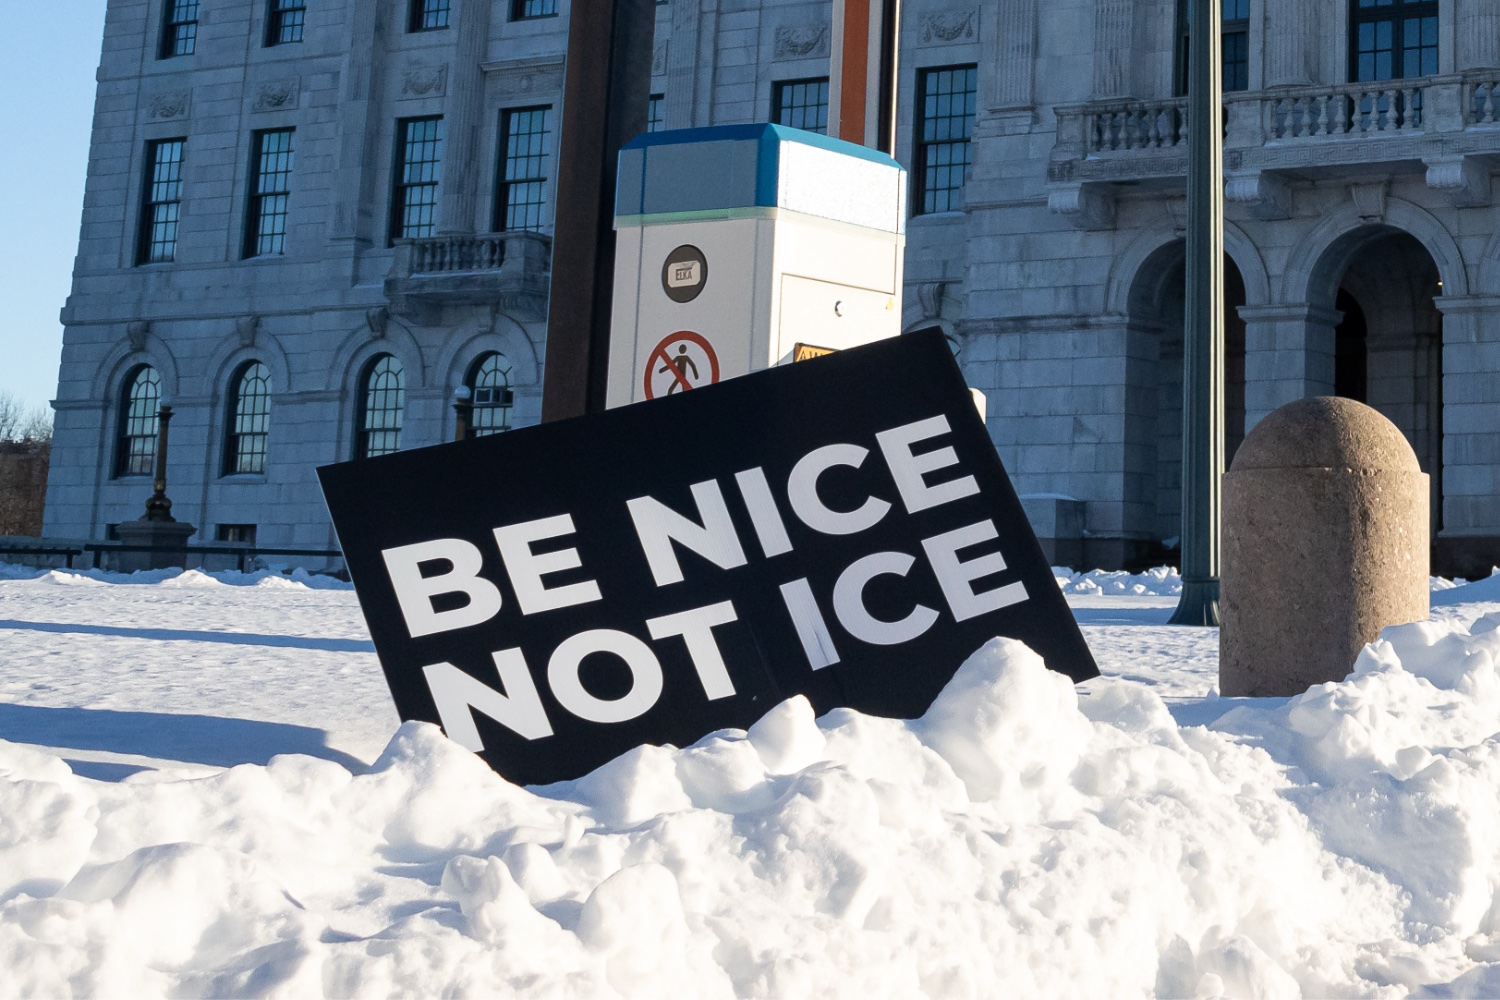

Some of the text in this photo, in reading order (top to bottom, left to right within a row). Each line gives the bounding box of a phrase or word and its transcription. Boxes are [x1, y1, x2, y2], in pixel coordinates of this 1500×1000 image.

[675, 267, 693, 281] ELKA
[382, 414, 981, 638] BE NICE
[421, 519, 1030, 752] NOT ICE
